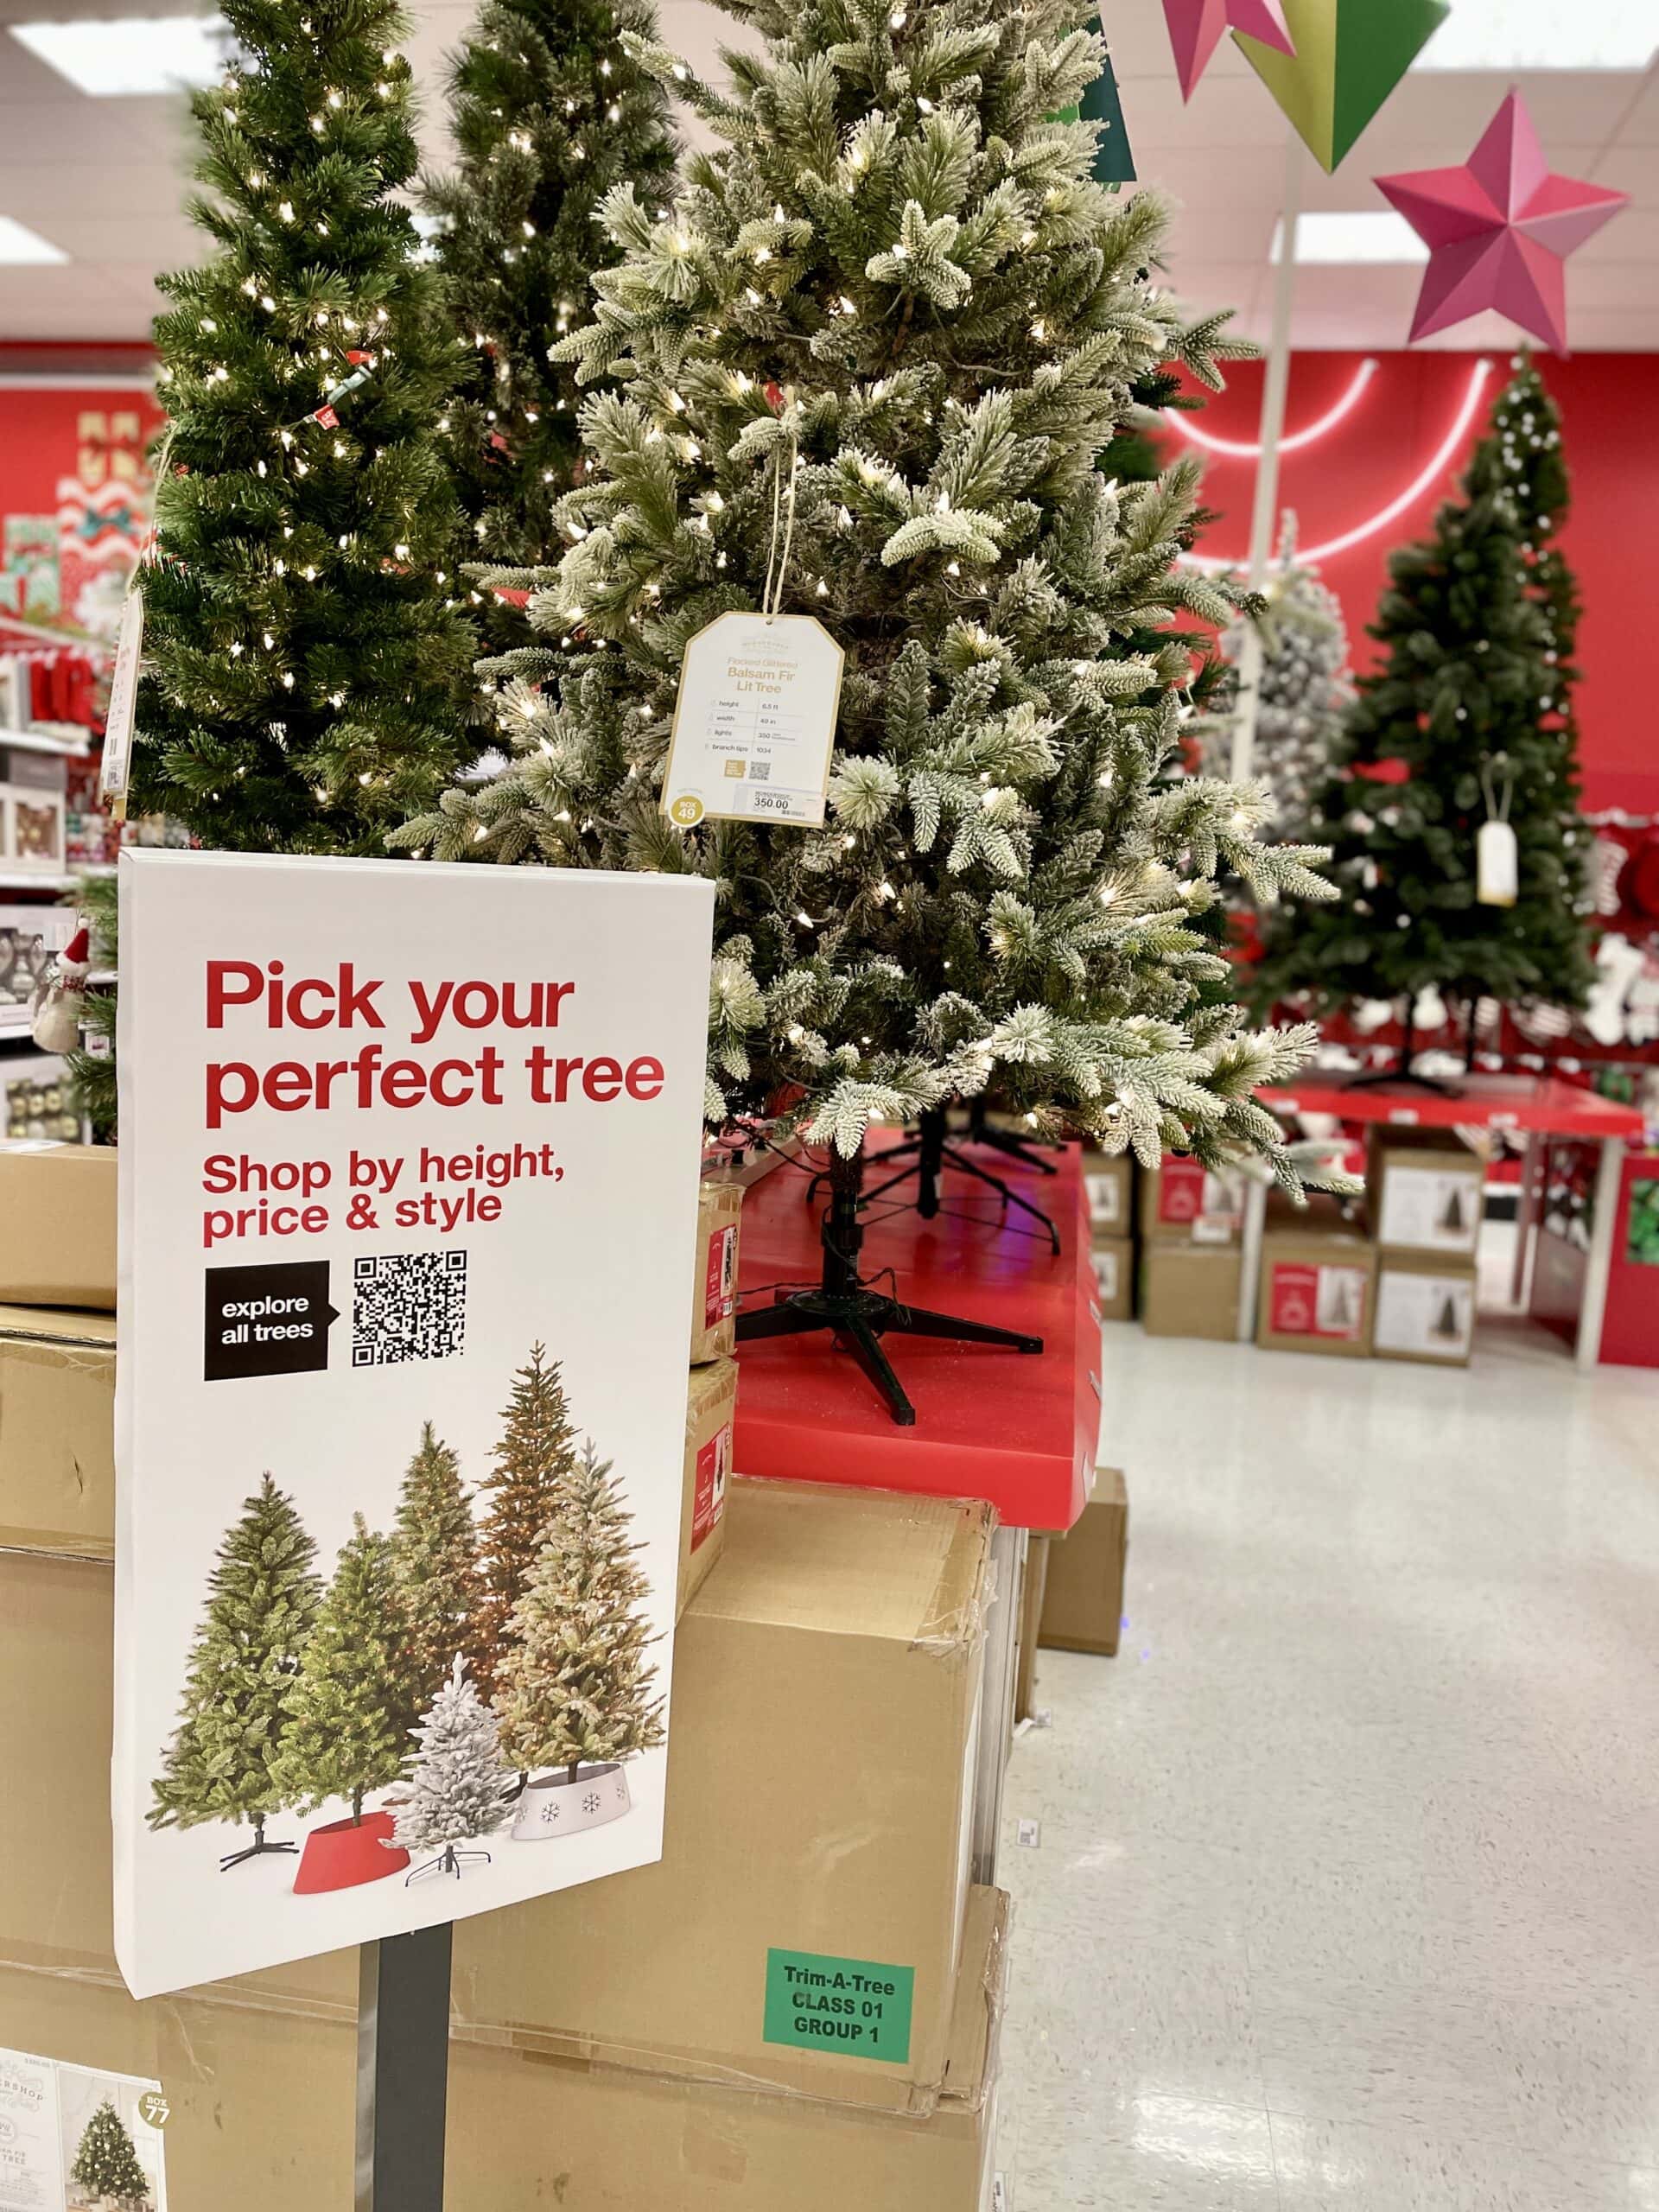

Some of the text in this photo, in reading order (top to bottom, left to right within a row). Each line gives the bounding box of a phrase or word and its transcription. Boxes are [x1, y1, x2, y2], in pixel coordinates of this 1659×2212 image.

[728, 666, 796, 682] Balsam Fir
[737, 680, 782, 694] Lit Tree
[678, 807, 696, 820] 49
[754, 797, 789, 810] 350.00
[206, 960, 575, 1044] Pick your
[205, 1044, 665, 1129] perfect tree
[202, 1143, 565, 1198] Shop by height,
[203, 1188, 502, 1248] price & style
[221, 1295, 309, 1323] explore
[221, 1320, 314, 1344] all trees
[784, 1966, 895, 1995] Trim-A-Tree
[792, 1992, 883, 2019] CLASS 01
[794, 2017, 879, 2043] GROUP 1
[145, 2104, 170, 2124] 77
[146, 2095, 168, 2107] BOX
